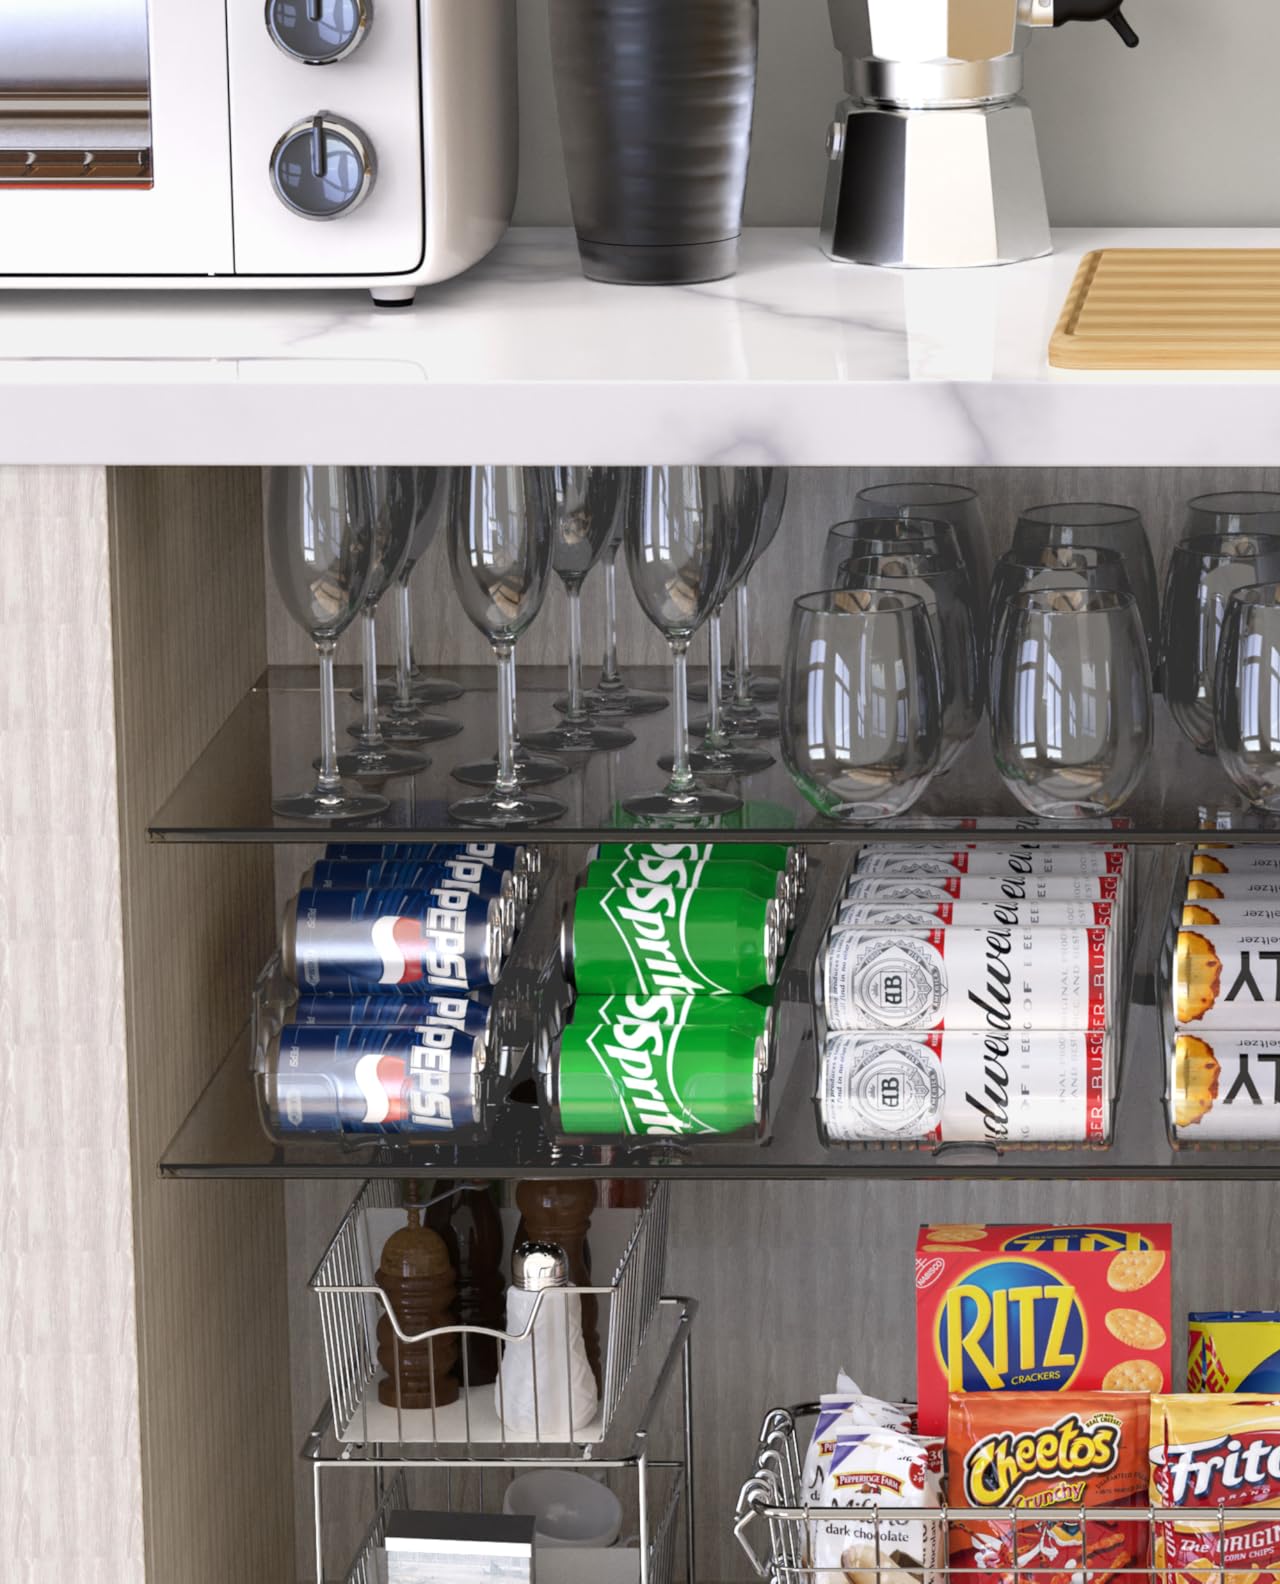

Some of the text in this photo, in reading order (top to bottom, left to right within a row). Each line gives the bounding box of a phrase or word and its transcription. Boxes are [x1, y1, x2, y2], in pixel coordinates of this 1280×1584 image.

[425, 888, 470, 990] PEPSI
[884, 975, 902, 1005] AB
[410, 1025, 454, 1129] PEPSI
[881, 1077, 900, 1108] AB
[917, 1259, 943, 1286] NABISCO
[946, 1284, 1076, 1392] RITZ
[1011, 1370, 1061, 1386] CRACKERS
[966, 1415, 1117, 1506] Cheetos
[839, 1473, 899, 1489] PEPPERIDGE FARM
[1217, 1487, 1271, 1503] BRAND
[825, 1523, 909, 1543] dark choolate
[1180, 1538, 1210, 1553] The
[1224, 1547, 1274, 1562] CORN CHIPS
